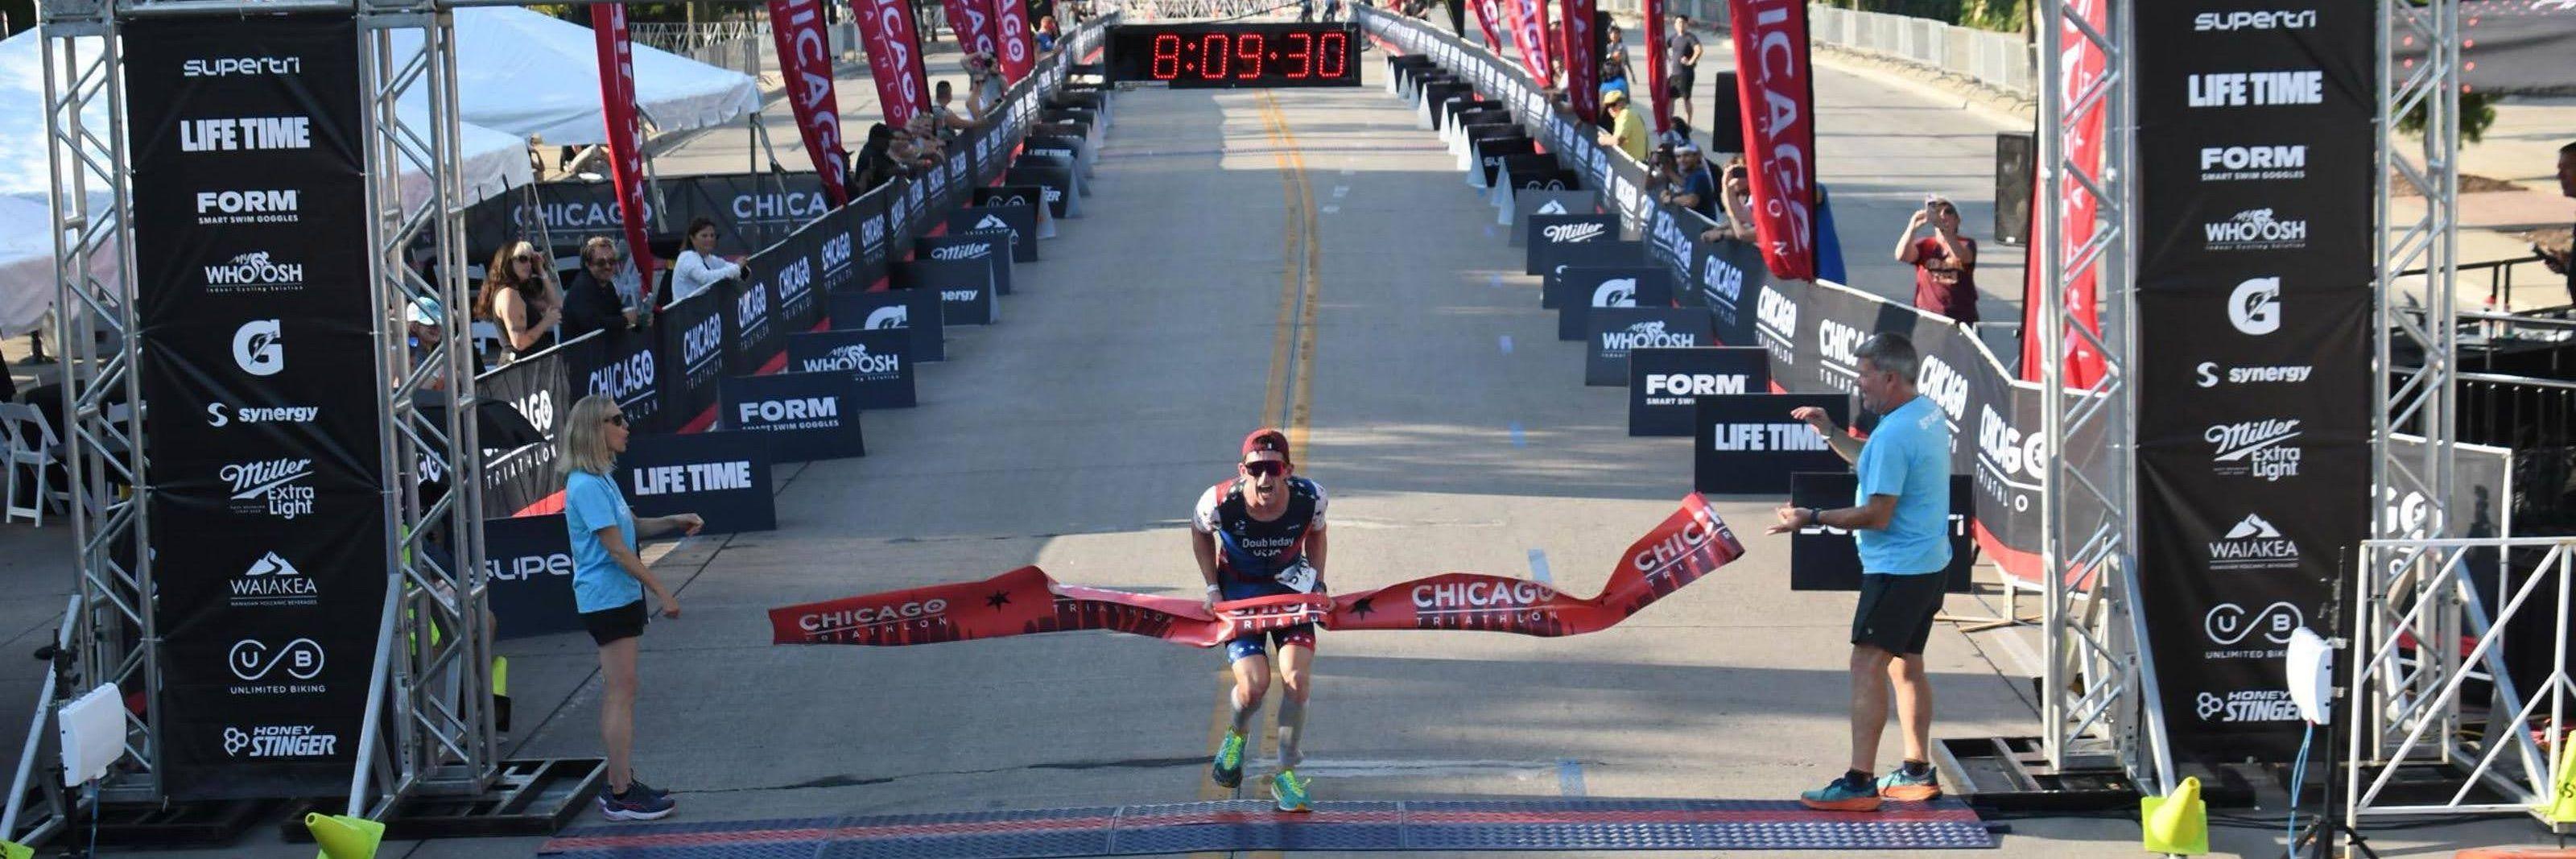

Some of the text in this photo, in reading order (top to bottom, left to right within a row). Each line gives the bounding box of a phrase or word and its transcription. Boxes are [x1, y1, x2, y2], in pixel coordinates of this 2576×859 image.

[2194, 10, 2316, 31] supertri
[184, 57, 300, 77] supertri
[2189, 71, 2322, 107] LIFE TIME
[180, 116, 311, 152] LIFE TIME
[2201, 145, 2306, 171] FORM
[197, 189, 297, 213] FORM
[733, 192, 828, 218] CHICA
[199, 214, 299, 225] SMART SWIM GOGGLES
[1543, 222, 1604, 242] Miller
[2205, 220, 2306, 242] WHOOSH
[204, 263, 303, 284] WHOOSH
[1757, 285, 1797, 338] CHICAGO
[684, 312, 721, 365] CHICAGO
[1602, 332, 1695, 349] WHOOSH
[1819, 319, 1864, 366] CHICA
[588, 349, 654, 399] CHICAGO
[803, 354, 899, 373] WHOOSH
[2228, 365, 2313, 383] synergy
[1646, 374, 1746, 394] FORM
[1917, 354, 1968, 421] CHICAGO
[238, 405, 319, 423] synergy
[739, 396, 837, 423] FORM
[1715, 423, 1765, 451] LIFE
[2204, 419, 2301, 455] Miller
[2252, 444, 2301, 461] Extra
[220, 458, 312, 493] Miller
[486, 444, 557, 489] TRIATHLON
[2253, 460, 2299, 481] Light
[634, 460, 752, 496] LIFE TIME
[267, 484, 315, 500] Extra
[270, 499, 313, 520] Light
[1242, 537, 1295, 549] Doubleday
[1634, 521, 1705, 571] CHIC
[1411, 580, 1557, 608] CHICAGO
[799, 598, 947, 630] CHICAGO
[1417, 611, 1558, 626] TRIATHLON
[2205, 650, 2264, 659] UNLIMITED
[230, 684, 326, 695] UNLIMITED BIKING
[254, 725, 314, 736] HONEY
[250, 735, 336, 757] STINGER
